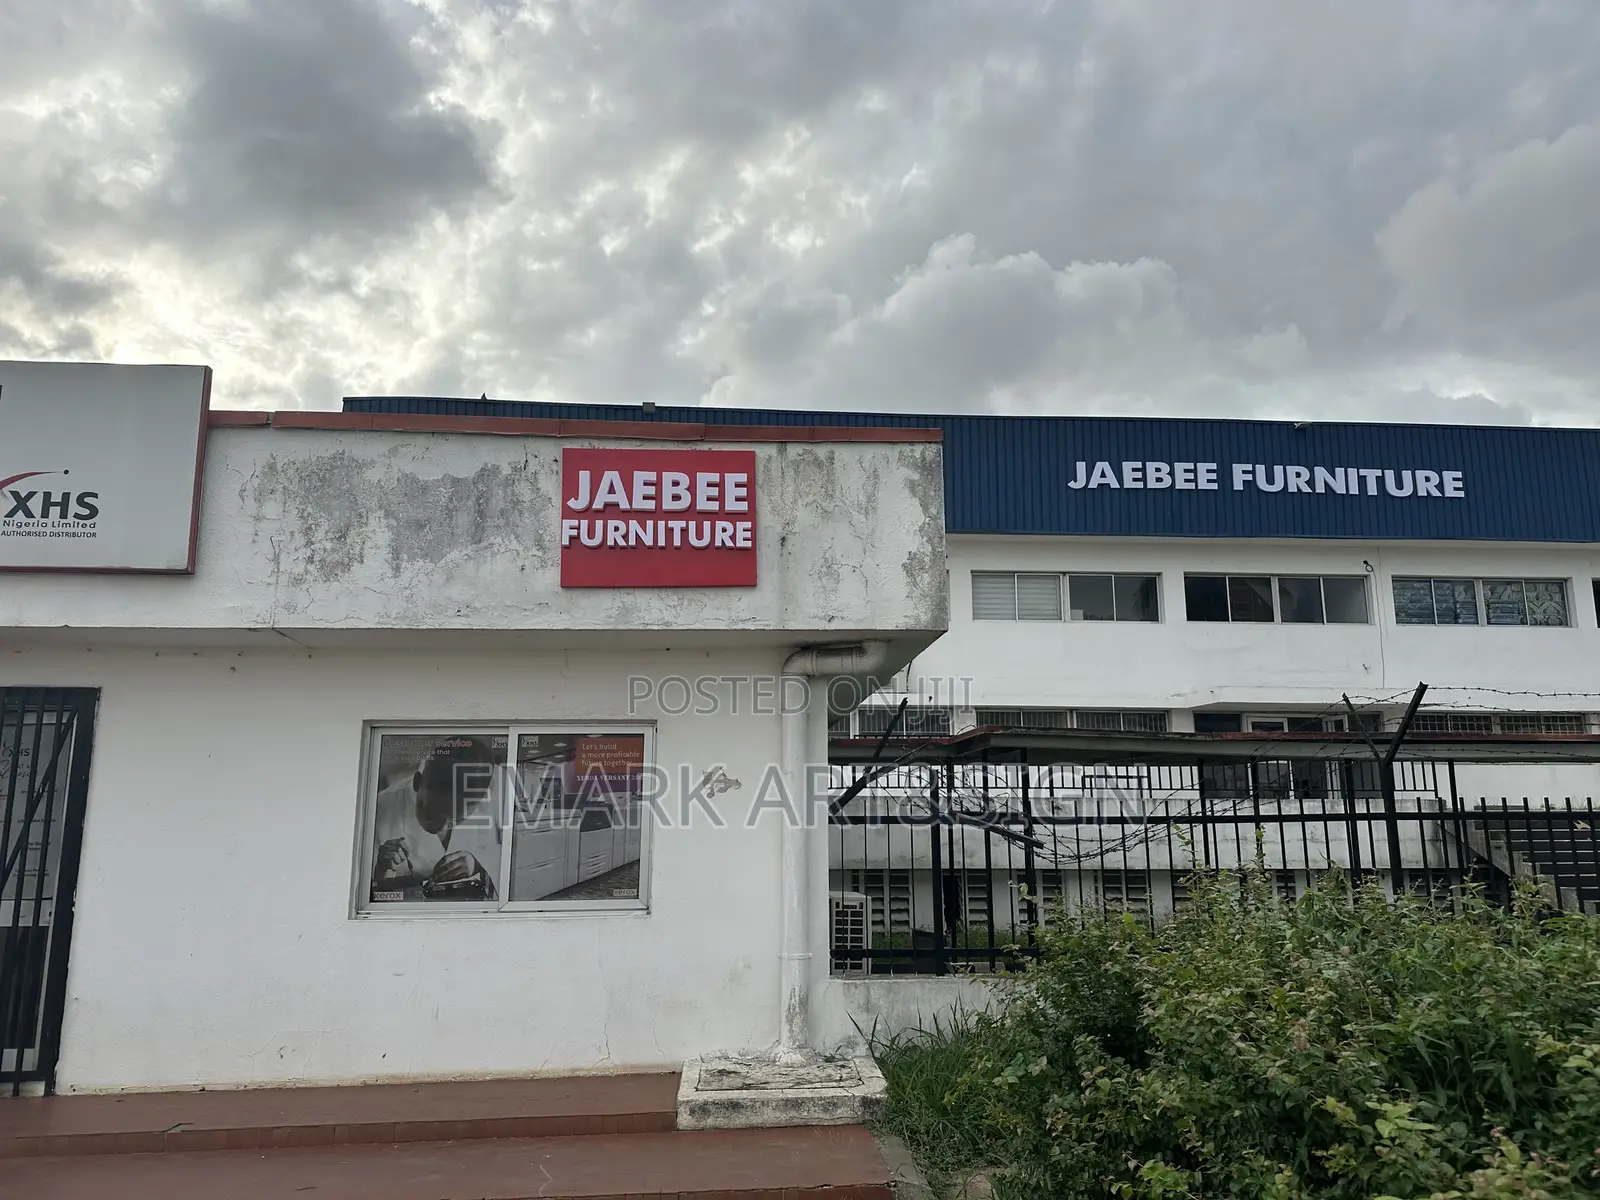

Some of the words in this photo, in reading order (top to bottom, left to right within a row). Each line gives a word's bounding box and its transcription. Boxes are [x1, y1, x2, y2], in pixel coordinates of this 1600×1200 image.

[1067, 461, 1219, 490] JAEBEE
[1232, 463, 1465, 498] FURNITURE
[567, 470, 749, 512] JAEBEE
[3, 490, 99, 520] XHS
[2, 520, 48, 528] Nigeria
[51, 521, 96, 529] Limited
[0, 530, 48, 538] AUTHORISED
[49, 531, 97, 539] DISTRIBUTOR
[561, 519, 752, 548] FURNITURE
[435, 739, 473, 748] Service
[606, 750, 641, 759] profitable
[581, 759, 603, 767] future
